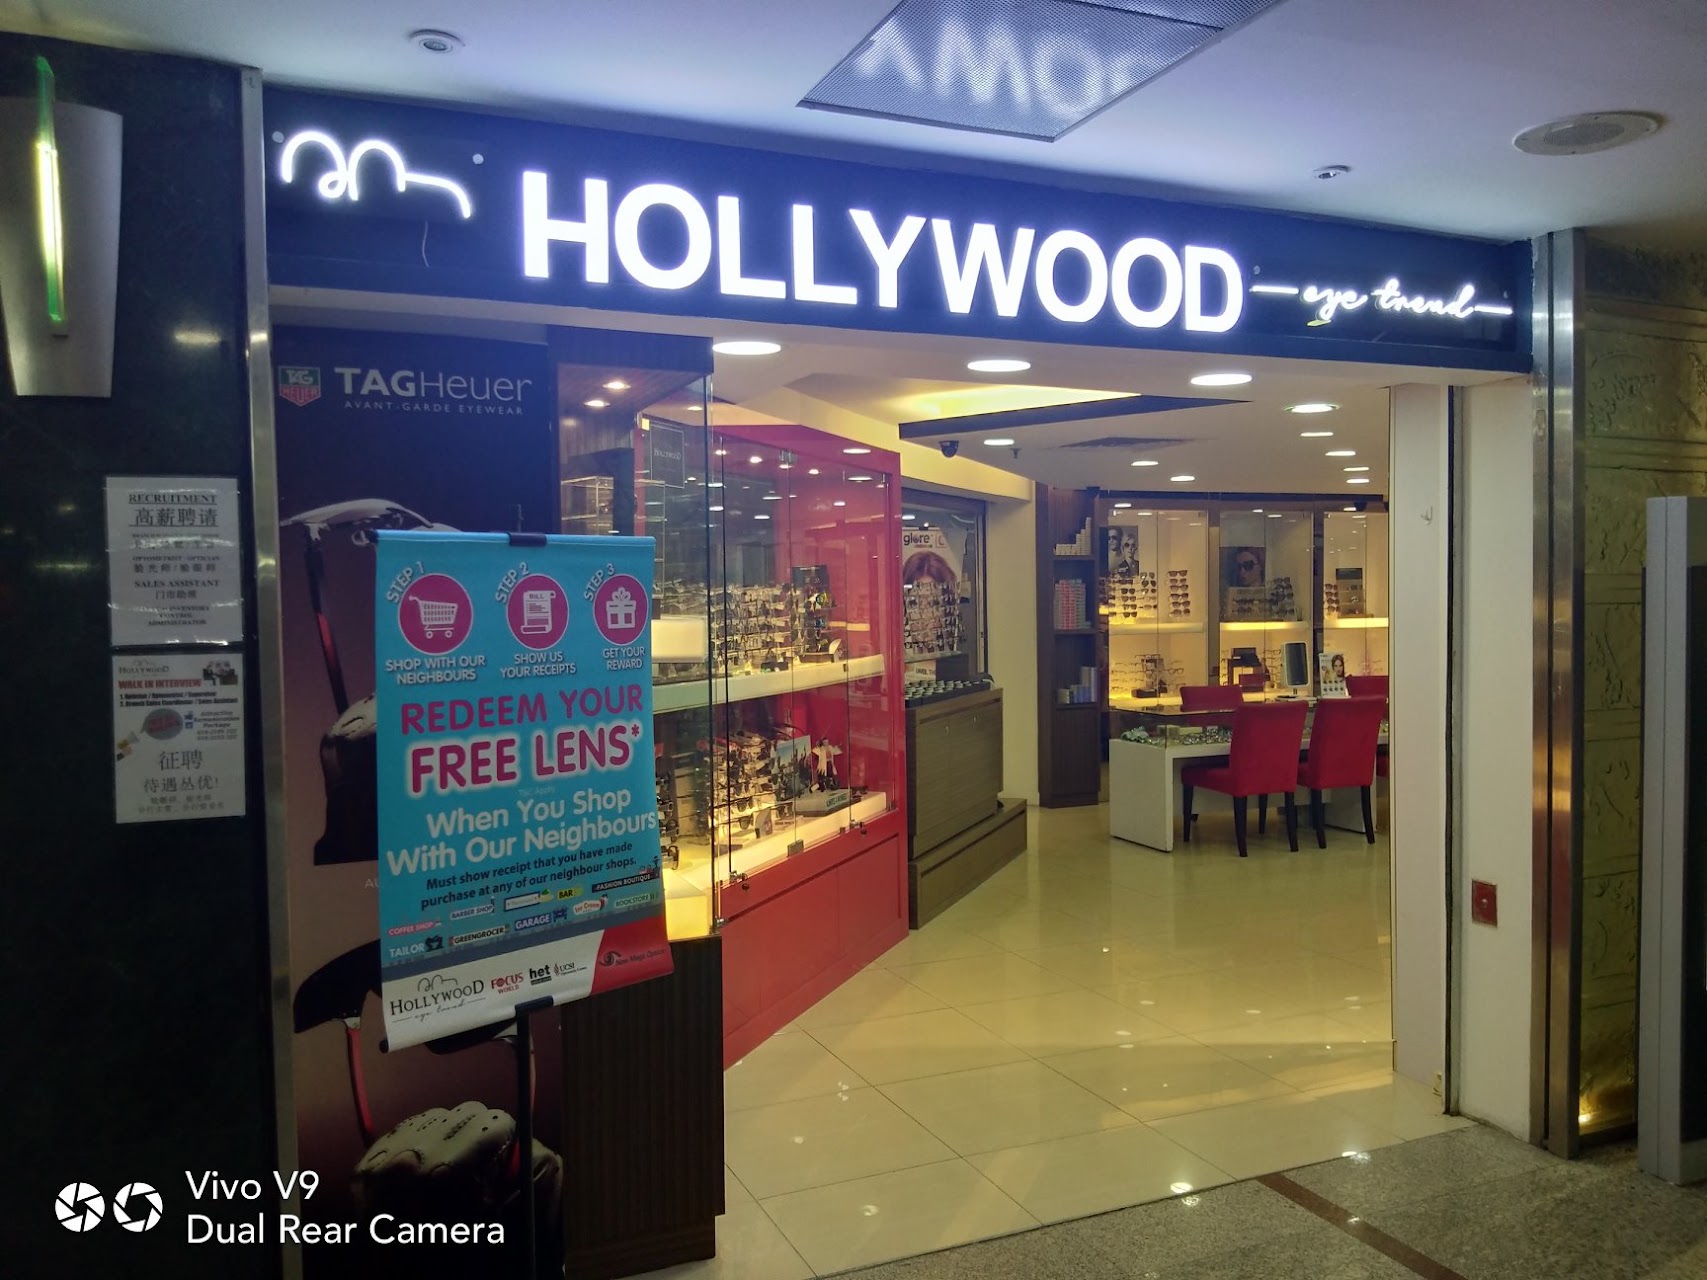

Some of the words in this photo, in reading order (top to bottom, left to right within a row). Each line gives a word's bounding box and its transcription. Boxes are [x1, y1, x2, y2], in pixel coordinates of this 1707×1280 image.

[522, 171, 1244, 333] HOLLYWOOD
[1302, 285, 1368, 320] eye
[1371, 277, 1475, 318] trend
[286, 370, 314, 384] TAG
[282, 387, 318, 403] HEUER
[459, 404, 523, 415] EYEWEAR
[129, 493, 217, 503] RECRUITMENT
[135, 507, 218, 526] 高薪聘请
[168, 579, 219, 587] ASSISTANT
[386, 567, 414, 604] STEP
[416, 561, 425, 574] 1
[496, 569, 518, 603] STEP
[518, 562, 530, 577] 2
[584, 569, 606, 602] STEP
[605, 563, 615, 576] 3
[514, 652, 545, 665] SHOW
[548, 650, 564, 663] US
[602, 648, 620, 659] GET
[620, 646, 645, 658] YOUR
[385, 658, 421, 672] SHOP
[424, 656, 457, 670] WITH
[459, 655, 486, 668] OUR
[500, 665, 532, 679] YOUR
[533, 663, 577, 677] RECEIPTS
[606, 658, 643, 671] REWARD
[118, 680, 144, 689] WALK
[146, 680, 154, 689] IN
[155, 678, 202, 689] INTERVIEW
[397, 669, 477, 685] NEIGHBOURS
[401, 692, 547, 735] REDEEM
[559, 684, 643, 719] YOUR
[160, 749, 203, 770] 征聘
[410, 737, 518, 794] FREE
[427, 806, 509, 839] When
[517, 799, 565, 823] You
[573, 788, 631, 815] Shop
[387, 842, 457, 877] With
[465, 836, 516, 863] Our
[524, 810, 656, 853] Neighbours
[427, 876, 457, 890] Must
[460, 869, 490, 884] show
[493, 861, 531, 879] receipt
[533, 856, 555, 869] that
[558, 853, 578, 867] you
[580, 848, 604, 860] have
[606, 842, 633, 855] made
[421, 888, 476, 911] purchase
[478, 885, 490, 897] at
[492, 881, 513, 894] any
[516, 876, 527, 889] of
[529, 875, 547, 886] our
[550, 862, 604, 881] neighbour
[605, 857, 637, 871] shops.
[596, 881, 623, 891] FASHION
[624, 874, 651, 885] BOUTIQUE
[559, 889, 573, 899] BAR
[451, 908, 475, 919] BARBER
[476, 904, 492, 914] SHOP
[388, 925, 415, 936] COFFEE
[416, 921, 433, 931] SHOP
[515, 914, 550, 930] GARAGE
[454, 927, 505, 944] GREENGROCER
[389, 943, 425, 957] TAILOR
[530, 964, 550, 979] het
[559, 962, 575, 974] UCSI
[491, 972, 523, 989] FOCUS
[498, 984, 519, 994] WORLD
[390, 980, 485, 1016] HOLLYWOOD
